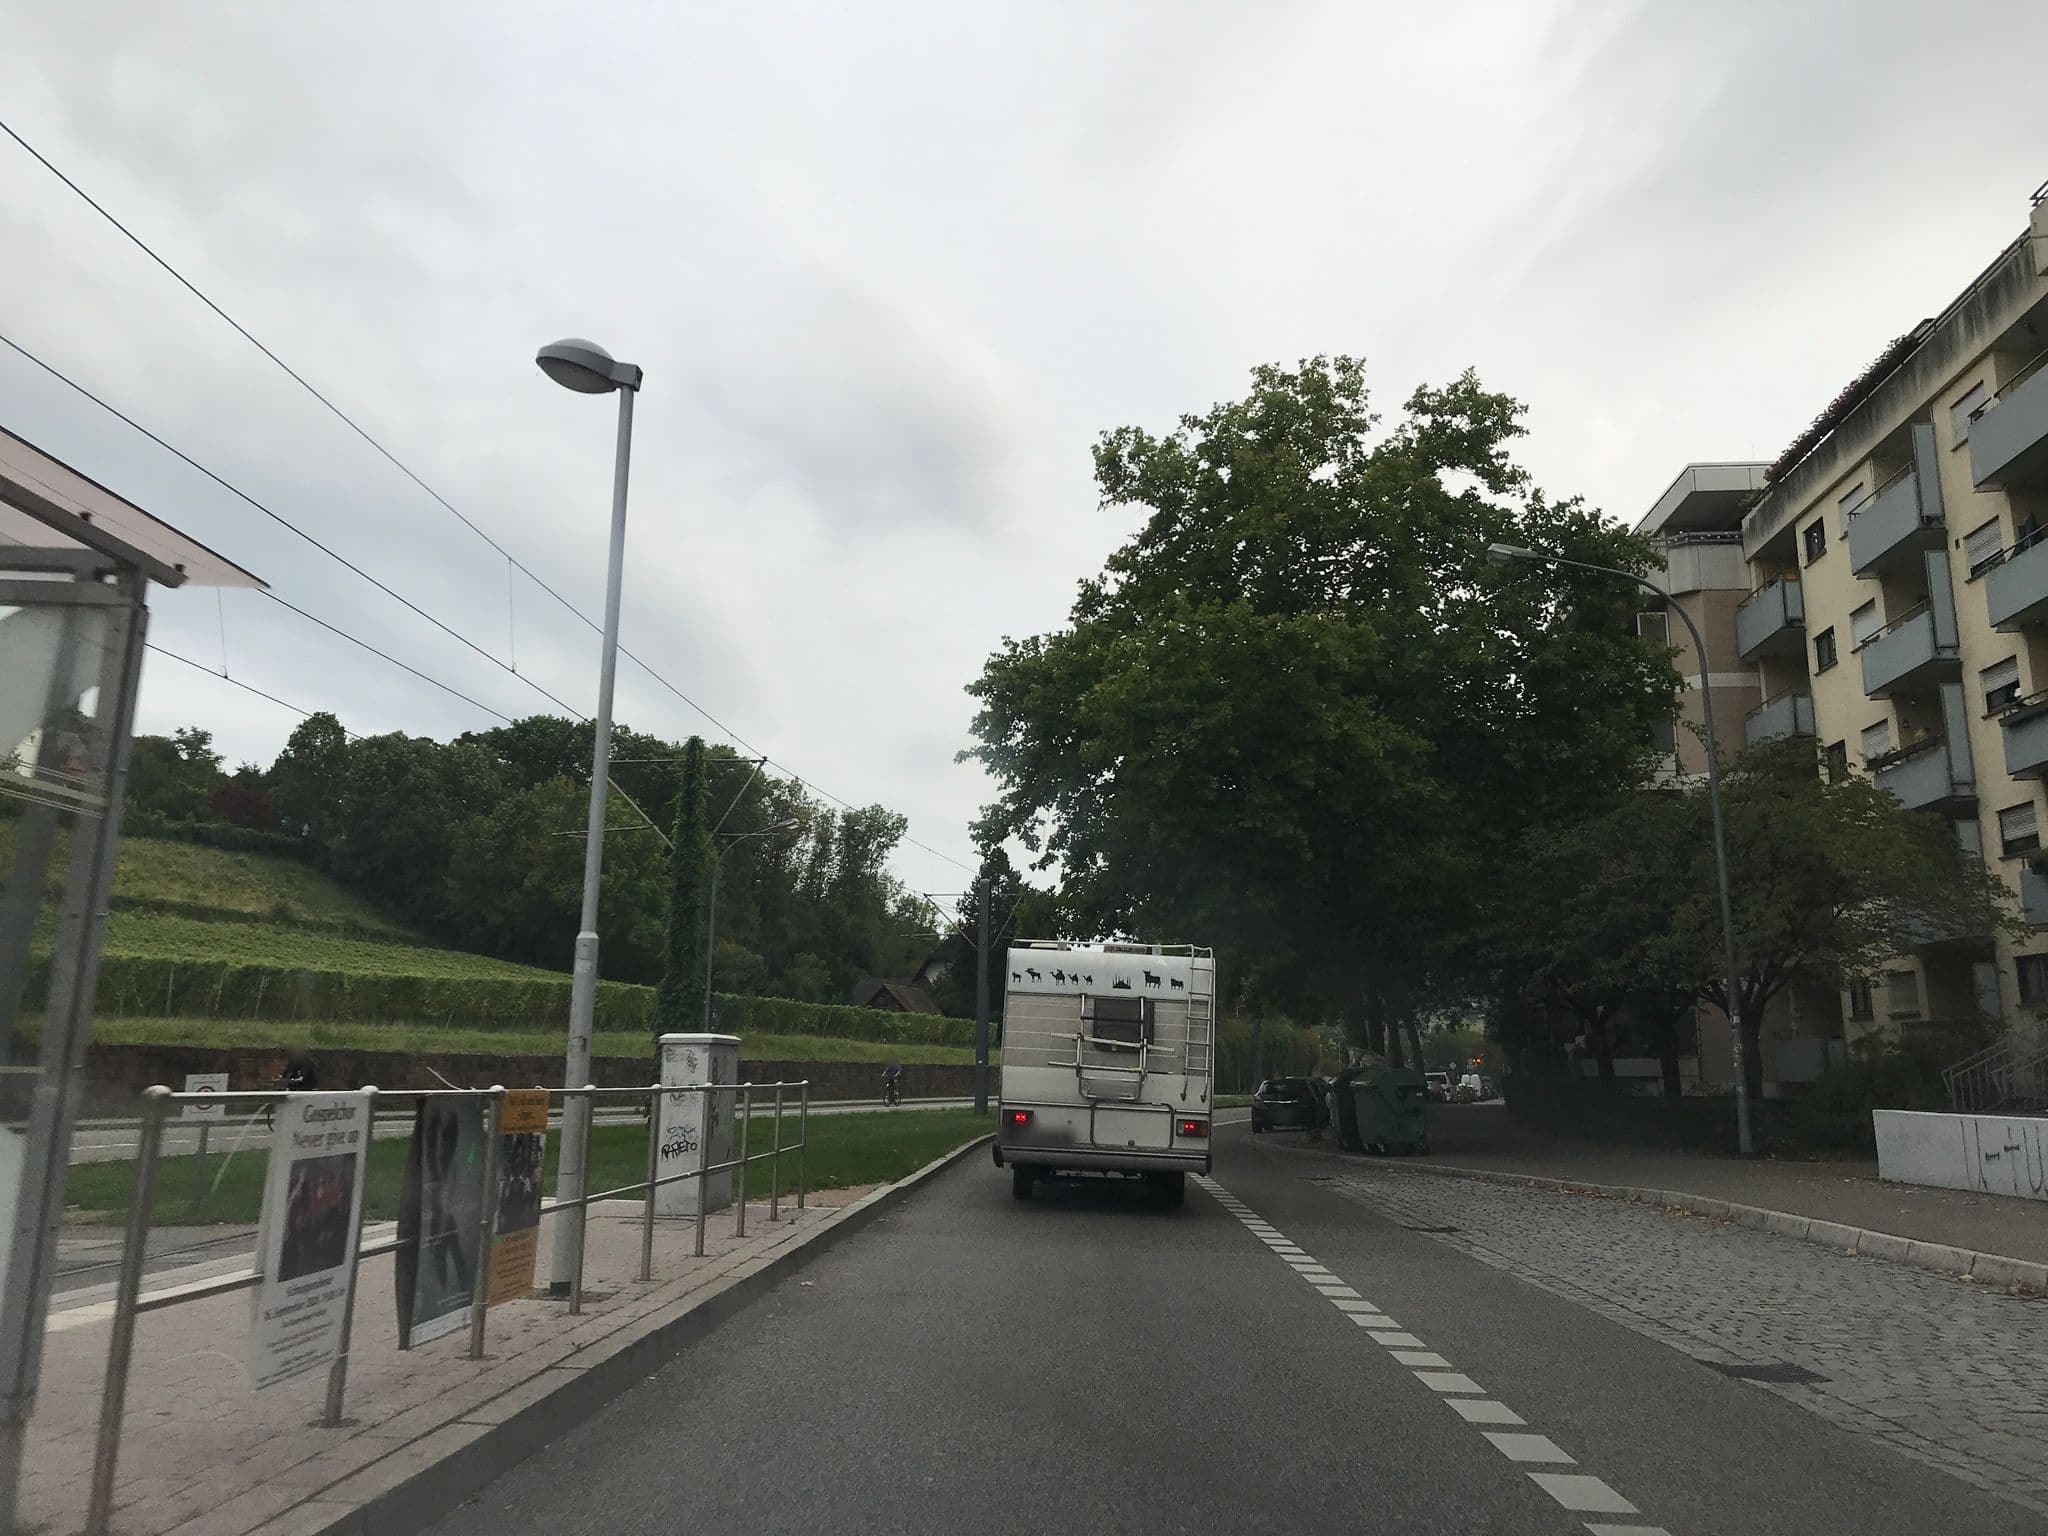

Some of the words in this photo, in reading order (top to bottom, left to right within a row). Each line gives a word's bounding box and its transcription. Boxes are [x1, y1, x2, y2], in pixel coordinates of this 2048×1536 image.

[303, 1102, 357, 1125] Gospelchor
[294, 1132, 322, 1148] Never
[327, 1128, 346, 1151] give
